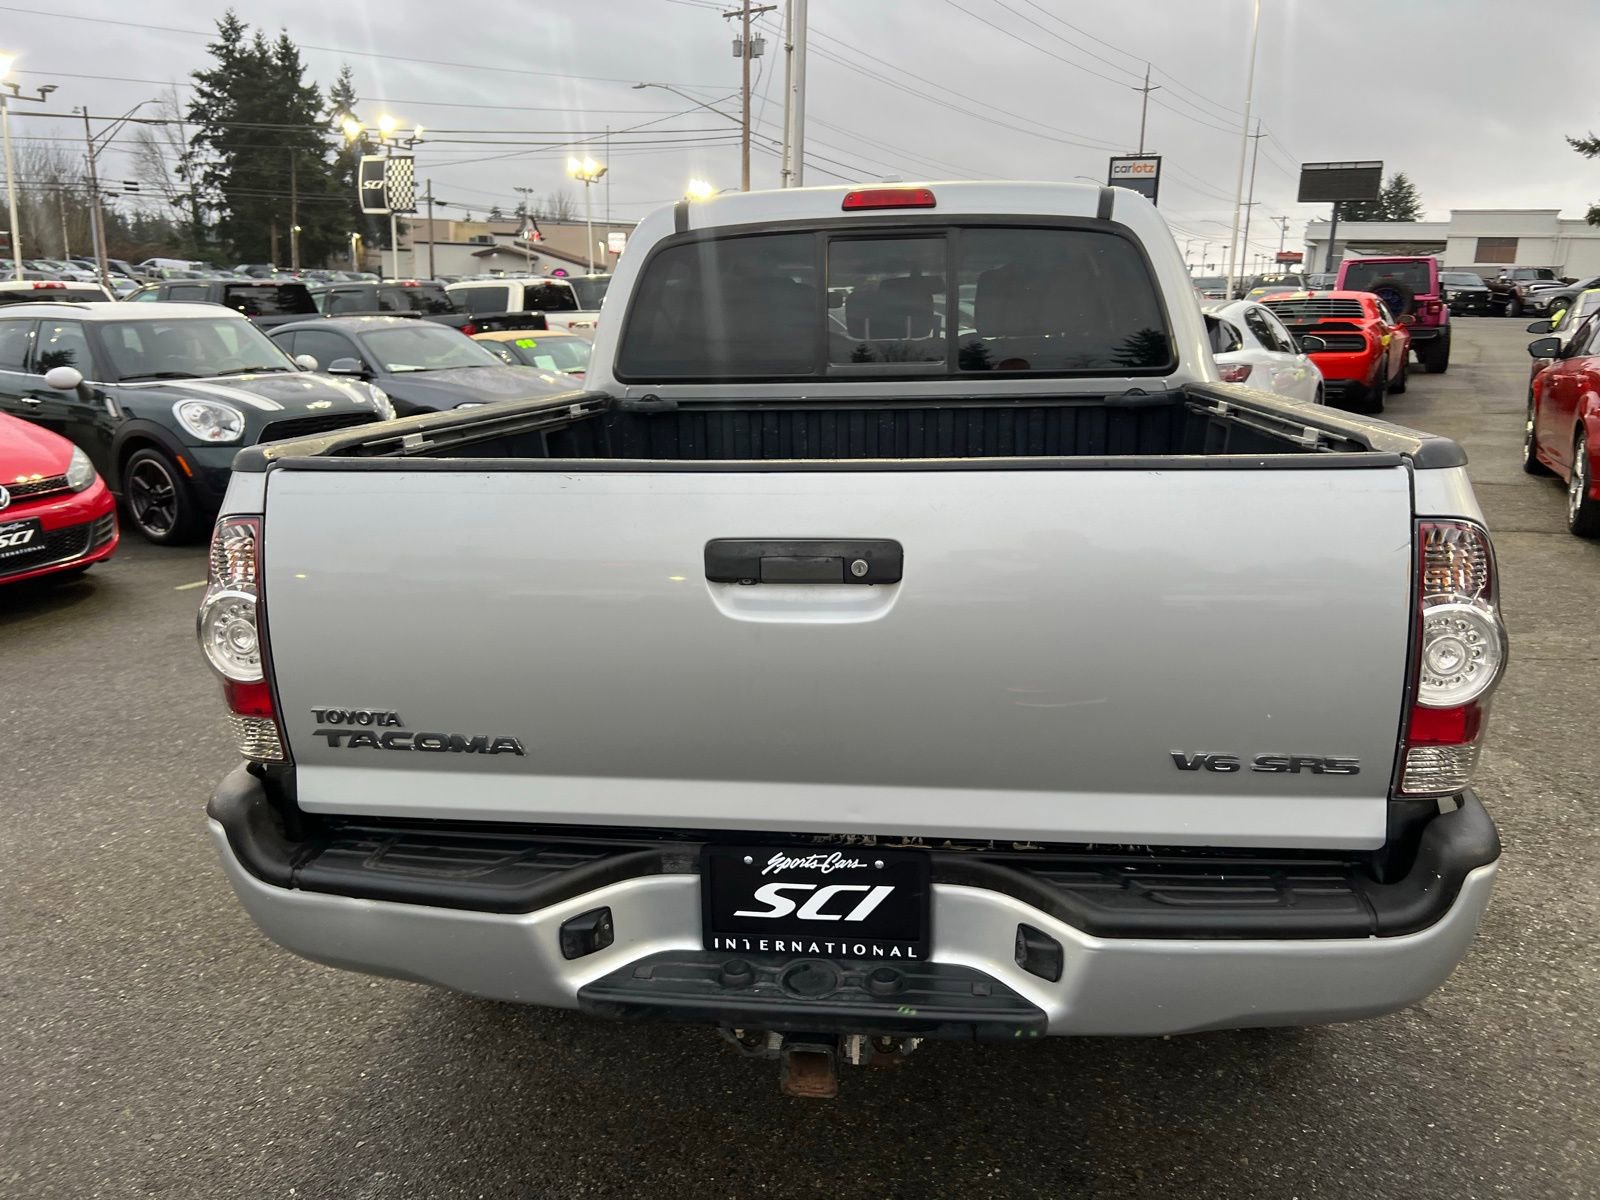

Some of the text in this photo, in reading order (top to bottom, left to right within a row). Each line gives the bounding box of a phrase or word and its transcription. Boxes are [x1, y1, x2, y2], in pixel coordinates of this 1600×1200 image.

[1114, 162, 1155, 174] carlotz
[311, 706, 403, 727] TOYOTA
[312, 729, 527, 757] TACOMA
[1170, 750, 1360, 775] V6 SR5
[761, 851, 868, 875] Sports Cars
[733, 882, 896, 922] SCI
